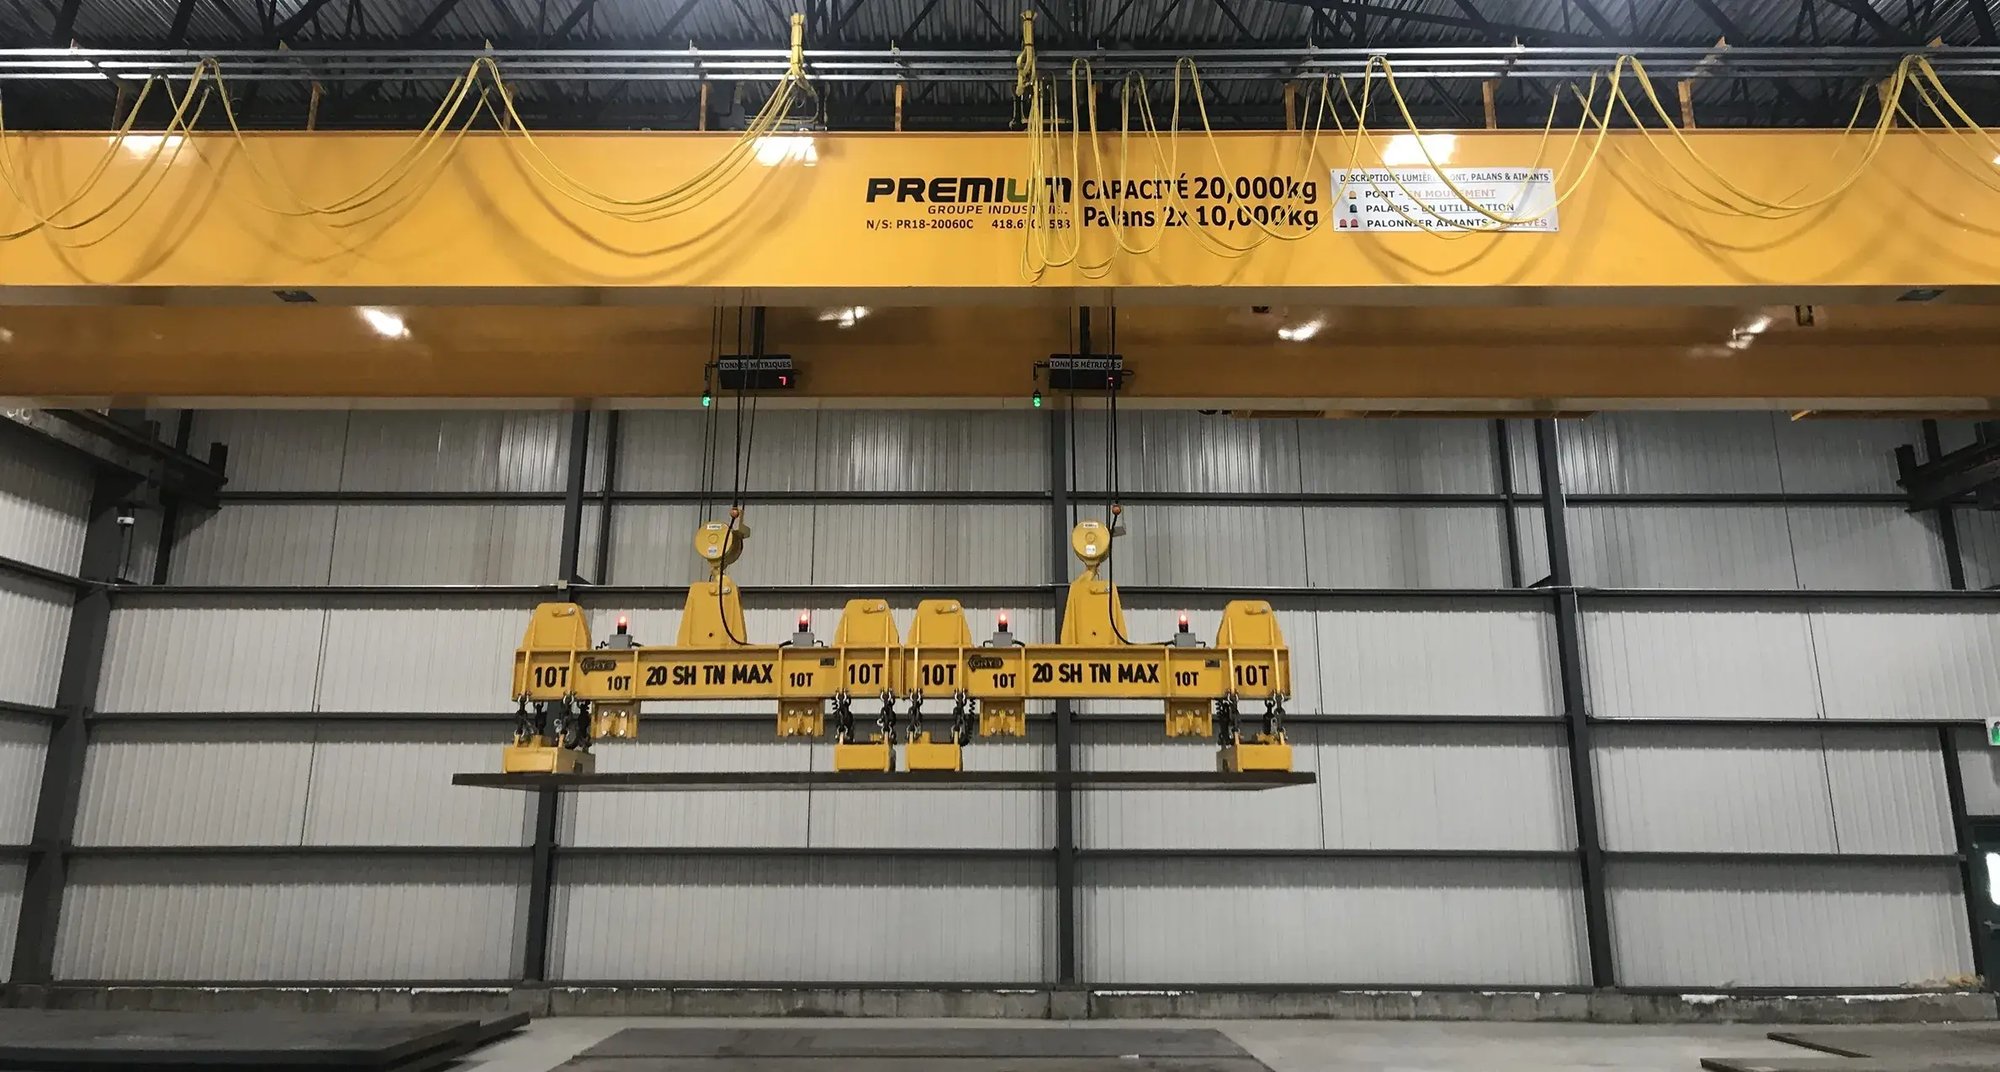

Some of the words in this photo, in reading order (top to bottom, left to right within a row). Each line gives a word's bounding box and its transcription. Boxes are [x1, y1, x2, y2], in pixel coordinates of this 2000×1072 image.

[1340, 173, 1400, 182] DSCRIPTIONS
[1471, 172, 1503, 181] PALANS
[1505, 172, 1511, 181] &
[1513, 172, 1549, 181] AIMANTS
[1365, 190, 1395, 198] PONT
[1425, 189, 1496, 198] MOUVMENT
[928, 205, 983, 214] GROUPE
[1440, 203, 1514, 212] UTILIATION
[1084, 205, 1155, 227] Palans
[866, 219, 892, 230] N/S:
[896, 219, 973, 229] PR18-20060C
[750, 361, 791, 369] MTRIQUES
[535, 666, 569, 688] 10T
[645, 665, 667, 687] 20
[672, 665, 697, 686] SH
[703, 665, 726, 685] TN
[732, 664, 773, 685] MAX
[789, 672, 814, 688] 10T
[848, 663, 883, 685] 10T
[922, 663, 957, 686] 10T
[992, 673, 1016, 689] 10T
[1032, 663, 1053, 683] 20
[1059, 663, 1082, 683] SH
[1089, 663, 1111, 683] TN
[1118, 663, 1159, 684] MAX
[1175, 671, 1199, 687] 10T
[1234, 665, 1269, 687] 10T
[607, 675, 631, 691] 10T
